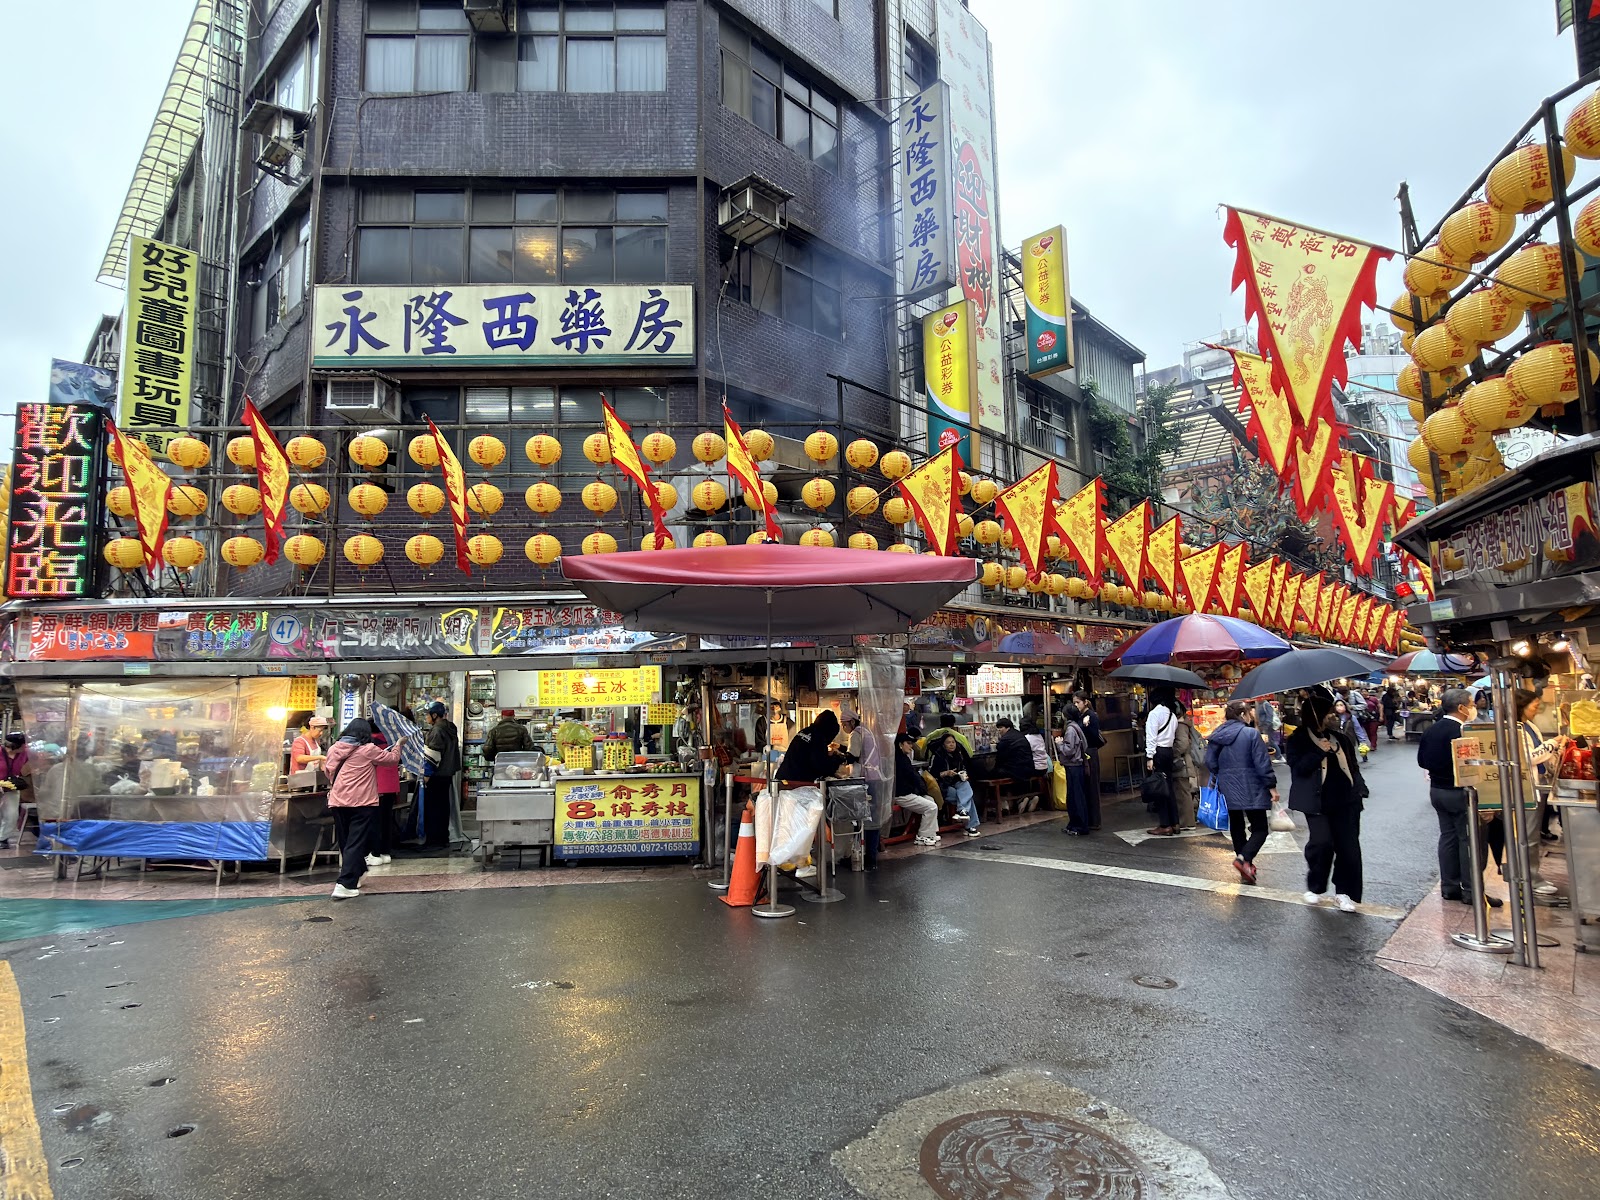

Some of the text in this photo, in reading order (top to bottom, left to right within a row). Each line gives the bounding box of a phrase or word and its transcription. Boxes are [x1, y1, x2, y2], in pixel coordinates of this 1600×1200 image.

[905, 96, 941, 291] 永隆西藥房
[957, 158, 992, 312] 迎財神
[1037, 258, 1050, 306] 公益彩券
[129, 242, 192, 434] 好兒童圖書玩具
[325, 289, 684, 356] 永隆西藥房
[940, 338, 953, 396] 公益彩券
[8, 404, 94, 595] 歡迎光臨
[40, 611, 257, 632] 海鮮鍋燒麵 廣東粥
[276, 620, 295, 639] 47
[480, 606, 491, 648] 基隆廟口
[976, 620, 985, 637] 43
[571, 681, 627, 695] 愛玉冰
[722, 691, 739, 700] 16:23
[609, 783, 687, 800] 俞秀月
[610, 801, 694, 819] 傅秀枝
